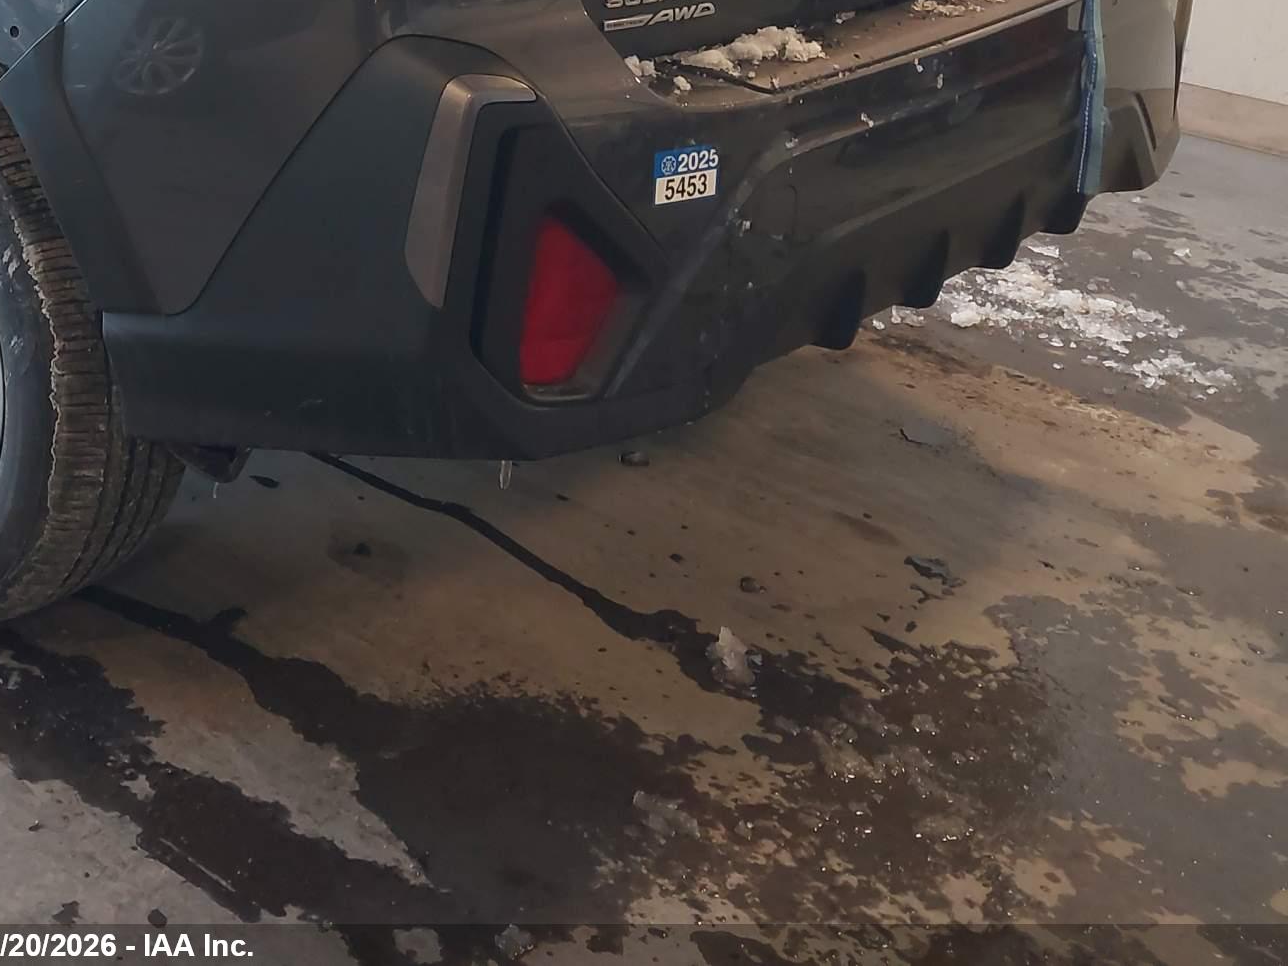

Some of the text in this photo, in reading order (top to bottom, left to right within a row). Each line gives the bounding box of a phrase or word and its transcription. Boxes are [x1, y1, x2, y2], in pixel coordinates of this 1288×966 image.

[648, 2, 715, 26] AWD
[677, 148, 719, 172] 2025
[665, 173, 708, 201] 5453
